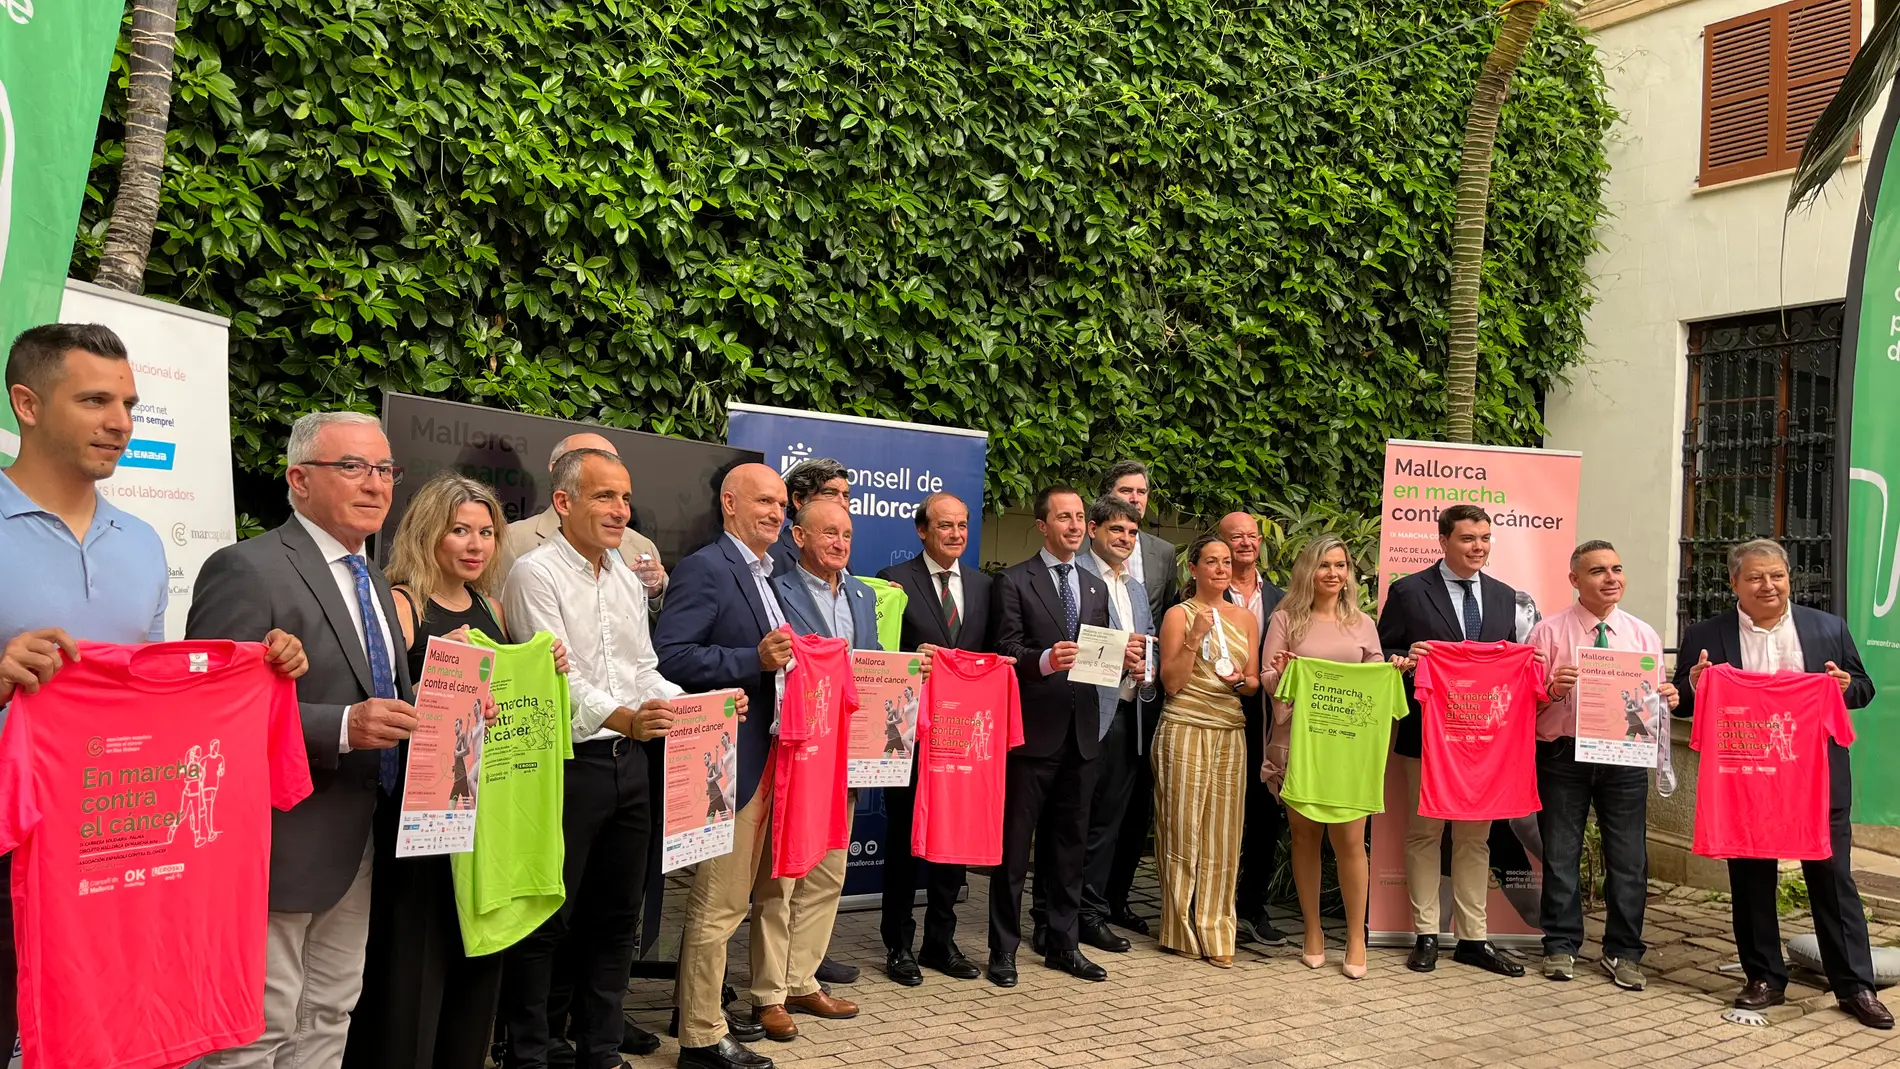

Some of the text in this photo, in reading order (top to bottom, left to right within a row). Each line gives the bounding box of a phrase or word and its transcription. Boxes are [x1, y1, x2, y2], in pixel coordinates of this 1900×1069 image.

[174, 369, 186, 381] de
[157, 406, 167, 415] net
[146, 416, 174, 428] sempre!
[411, 414, 529, 455] Mallorca
[1395, 458, 1487, 480] Mallorca
[917, 470, 943, 493] de
[112, 484, 115, 496] i
[1393, 485, 1506, 504] en marcha
[1493, 510, 1563, 530] cáncer
[429, 649, 460, 665] Mallorca
[1098, 645, 1104, 659] 1
[1582, 653, 1614, 661] Mallorca
[855, 657, 885, 666] Mallorca
[427, 665, 463, 679] en marcha
[424, 678, 448, 690] contra
[449, 681, 455, 691] el
[457, 682, 478, 694] cáncer
[1313, 683, 1363, 698] En marcha
[1312, 693, 1343, 704] contra
[1448, 691, 1499, 700] En marcha
[672, 704, 702, 715] Mallorca
[1311, 701, 1355, 714] el cáncer
[933, 713, 981, 727] En marcha
[1446, 711, 1456, 719] el
[1717, 719, 1780, 729] En marcha
[670, 727, 692, 738] contra
[694, 724, 700, 734] el
[931, 726, 961, 736] contra
[1717, 730, 1756, 739] contra
[930, 736, 972, 748] el cáncer
[1718, 740, 1773, 750] el cáncer
[84, 760, 200, 788] En marcha
[81, 789, 156, 813] contra
[80, 811, 184, 838] el cáncer
[124, 868, 146, 882] OK
